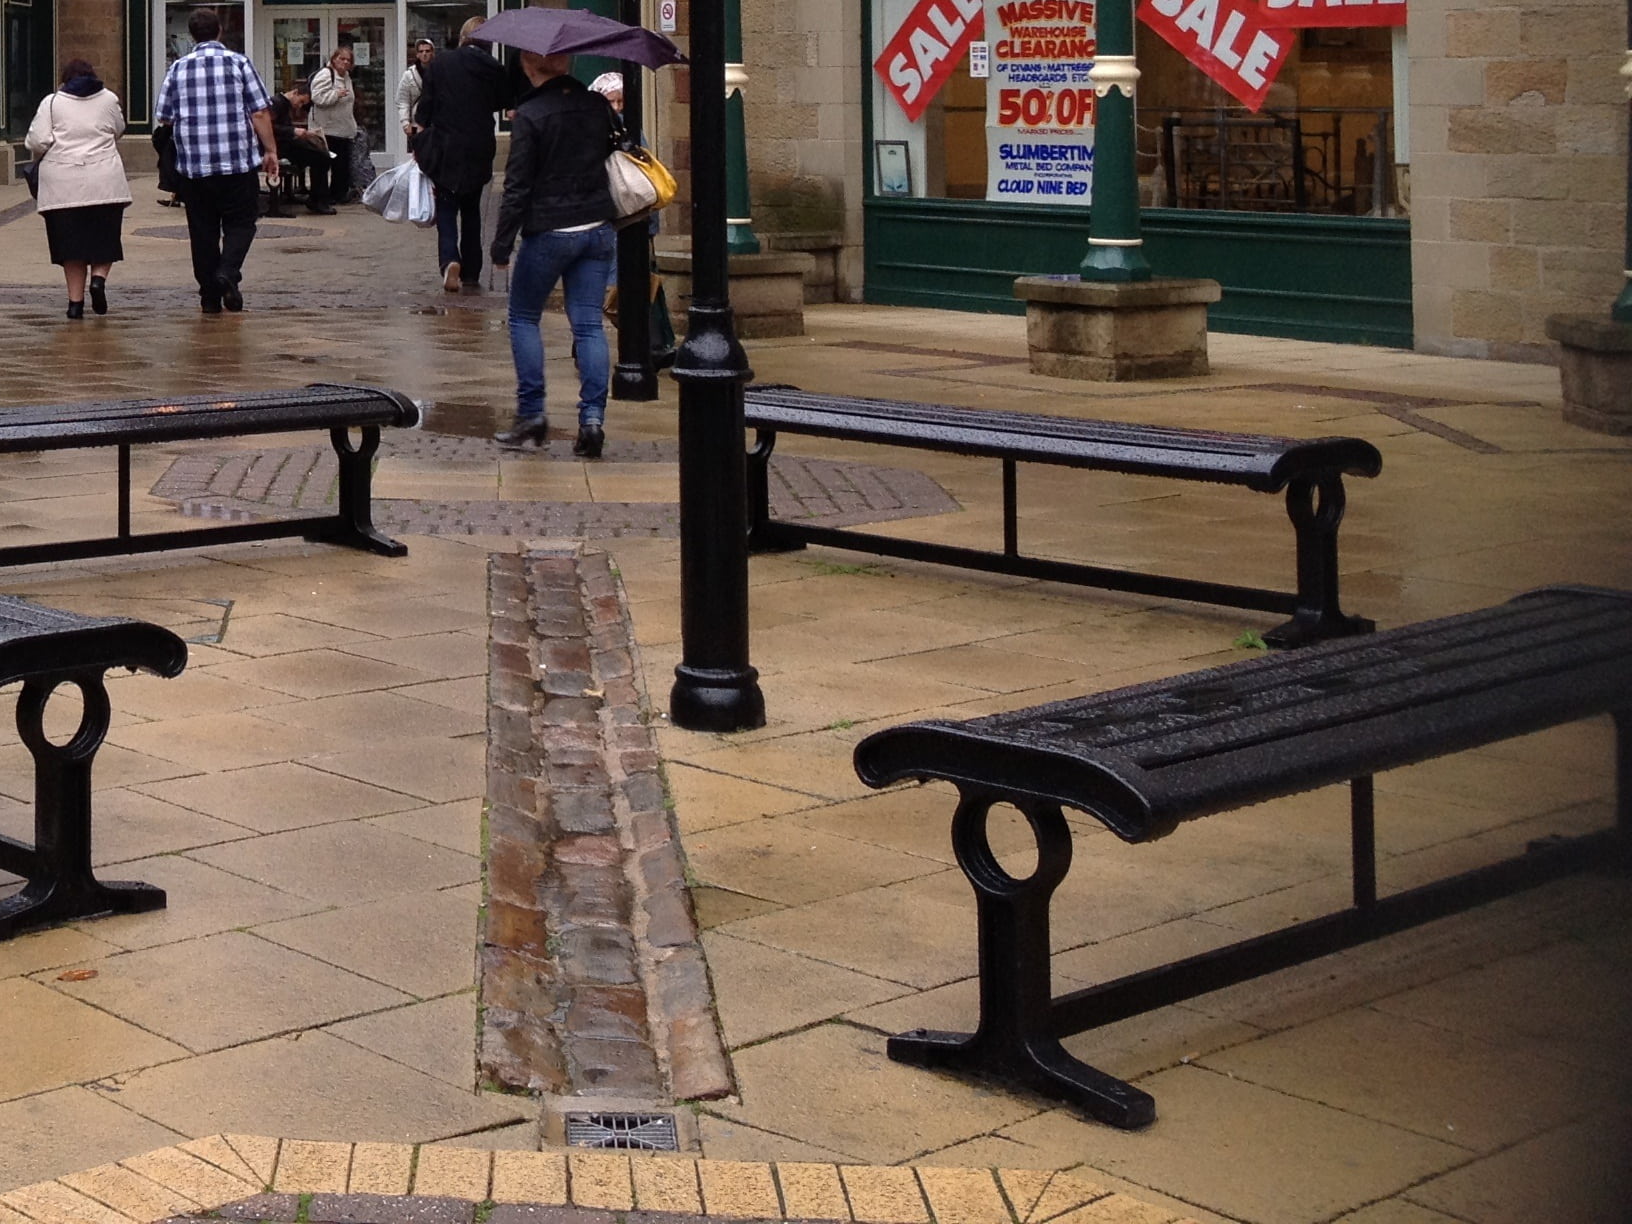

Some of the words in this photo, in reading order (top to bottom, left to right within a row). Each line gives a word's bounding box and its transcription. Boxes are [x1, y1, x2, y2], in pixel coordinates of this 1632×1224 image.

[1010, 26, 1087, 39] WAREHOUSE
[996, 39, 1096, 60] CLEARANC
[997, 63, 1008, 72] OF
[1011, 63, 1041, 73] DIVANS
[1009, 73, 1067, 83] HEADBOARDS
[999, 143, 1095, 161] SLUMBERTIM
[1005, 162, 1032, 171] METAL
[1036, 163, 1053, 172] BED
[998, 179, 1033, 194] CLOUD
[1037, 180, 1064, 195] NINE
[1066, 180, 1088, 195] BED
